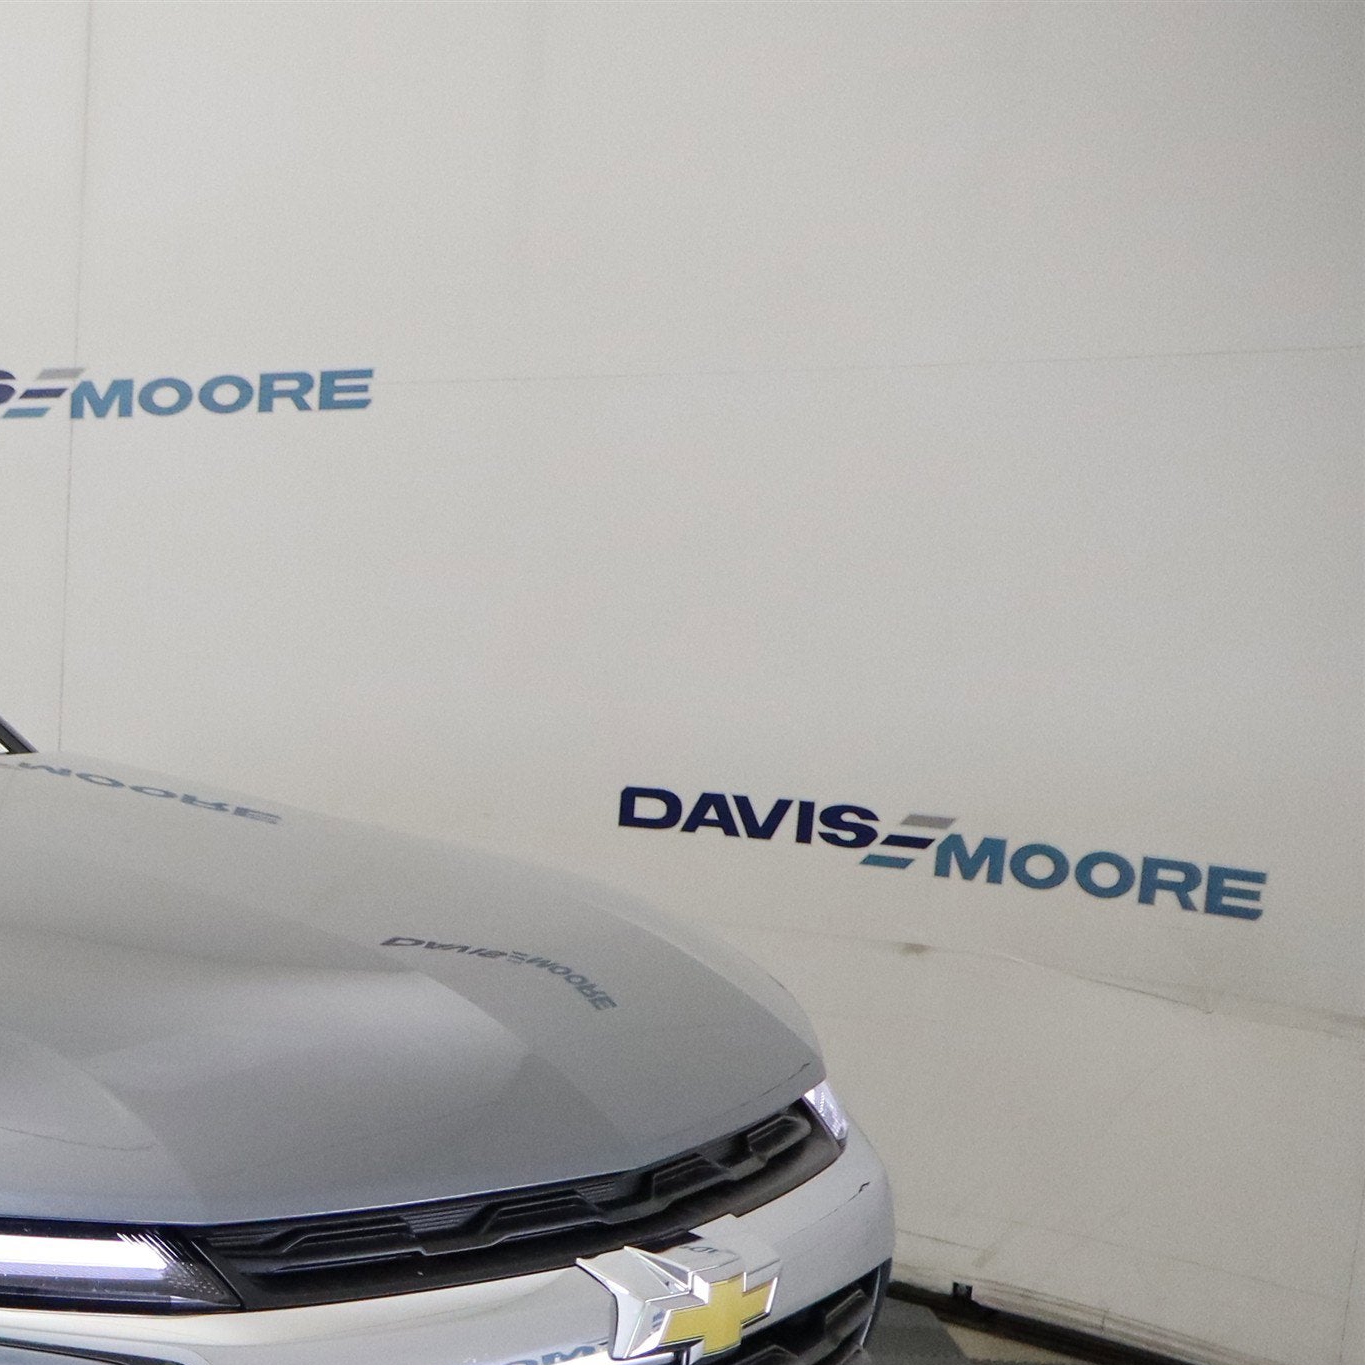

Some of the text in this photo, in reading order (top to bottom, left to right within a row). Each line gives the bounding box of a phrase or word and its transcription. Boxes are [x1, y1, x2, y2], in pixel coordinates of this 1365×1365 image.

[70, 368, 375, 420] MOORE
[616, 785, 1268, 921] DAVIS MOORE
